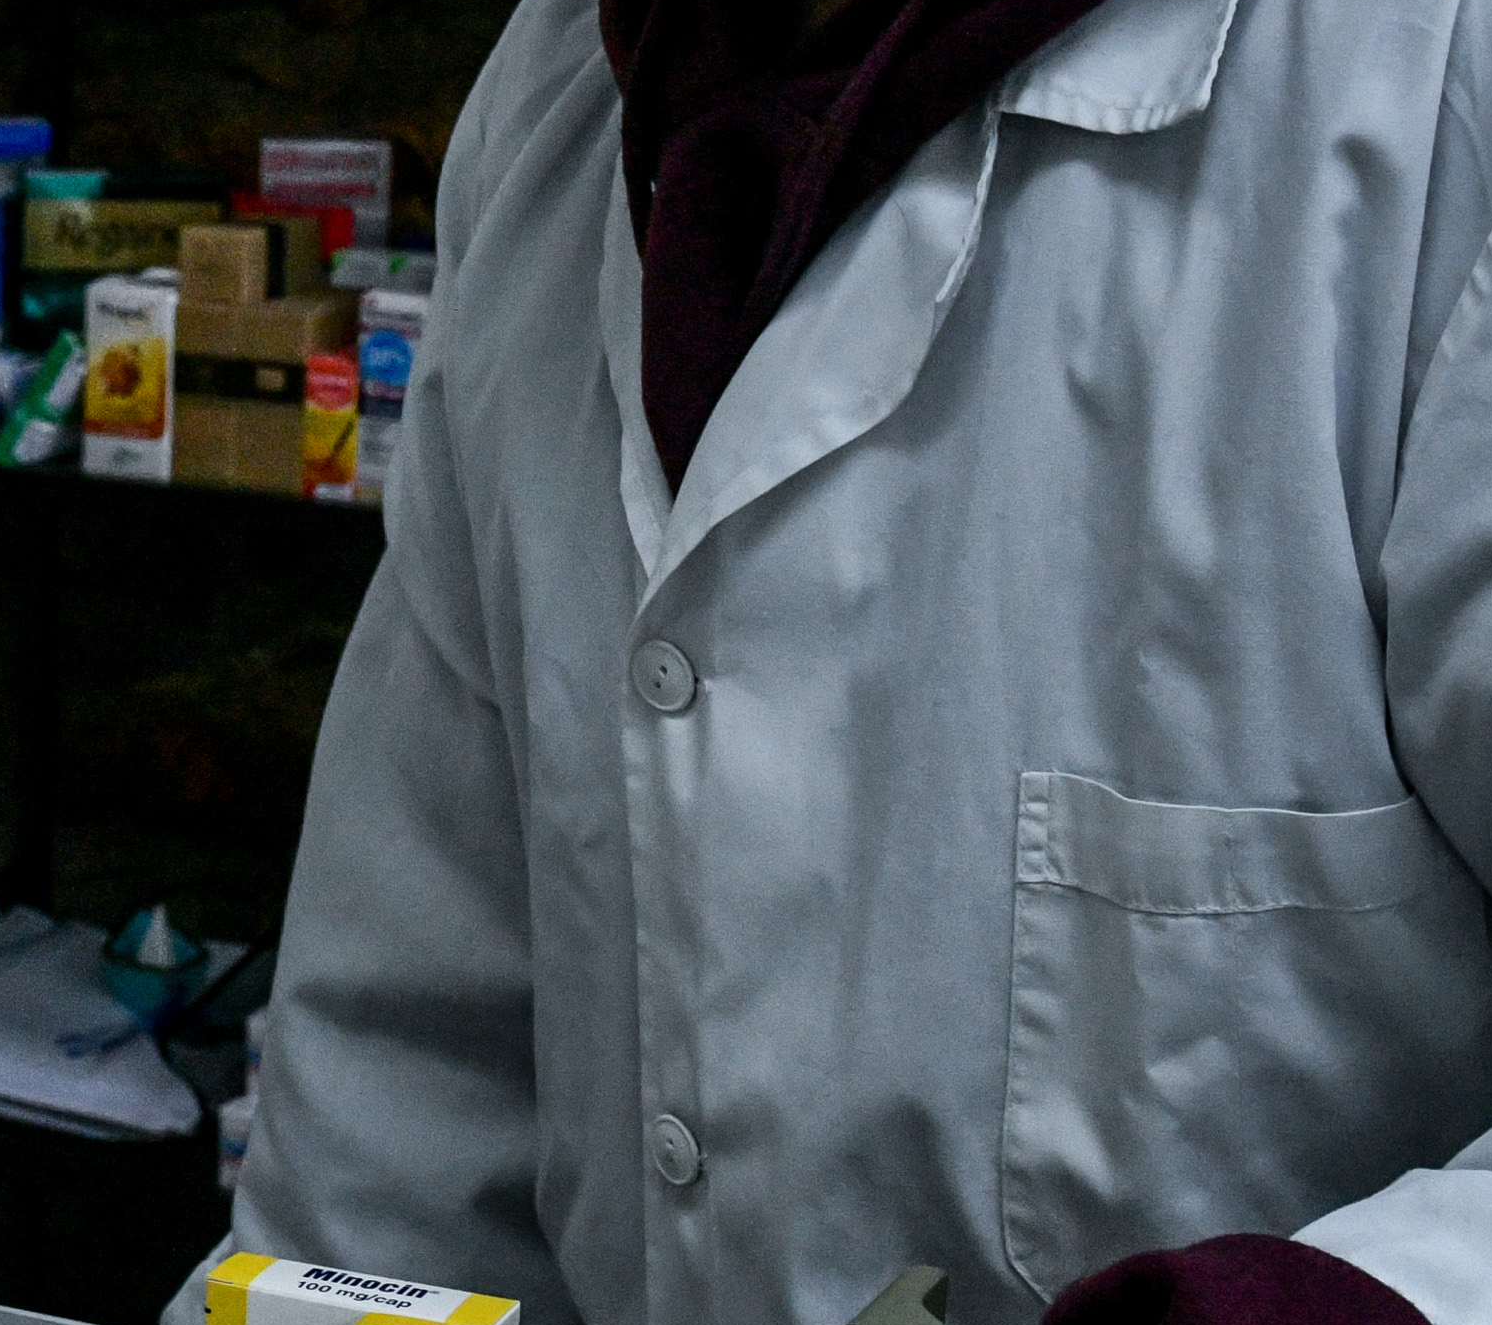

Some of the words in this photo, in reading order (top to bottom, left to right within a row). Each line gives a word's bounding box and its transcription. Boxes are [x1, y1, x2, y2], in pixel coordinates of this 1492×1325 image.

[296, 1280, 325, 1295] 100
[327, 1285, 413, 1311] mg/cap
[302, 1267, 429, 1299] Minocin
